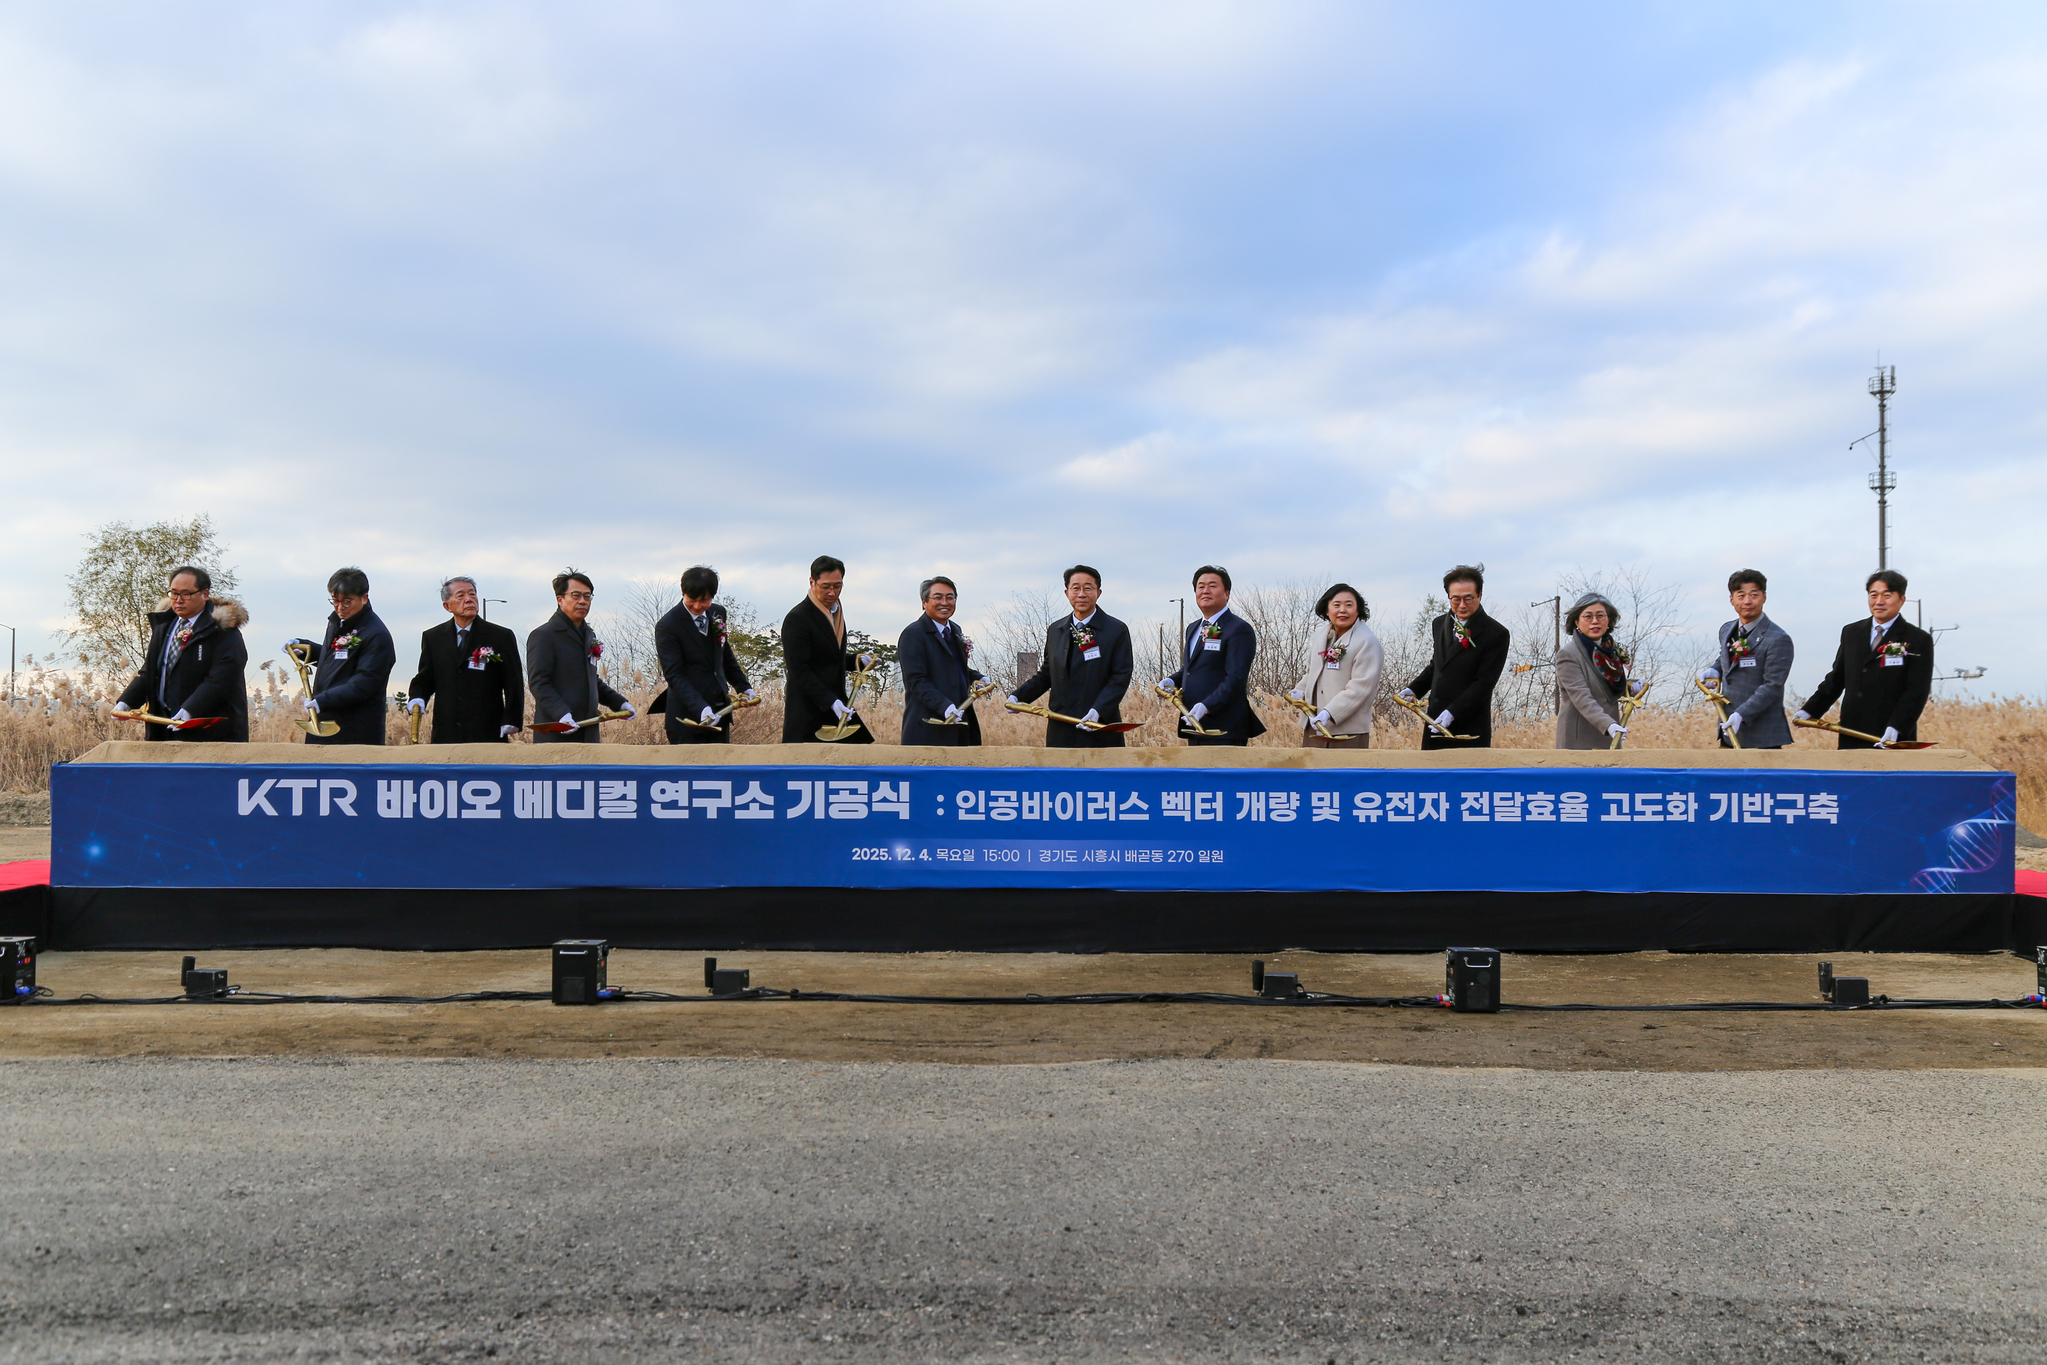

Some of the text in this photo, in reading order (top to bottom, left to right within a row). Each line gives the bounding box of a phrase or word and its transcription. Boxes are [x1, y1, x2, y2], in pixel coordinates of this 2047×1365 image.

[238, 779, 1839, 824] KTR 바이오 메디컬 연구소 기공식 : 인공바이러스 벡터 개량 및 유전자 전달효율 고도화 기반구축
[852, 848, 1223, 862] 2025. 12. 4. 목요일 15:00 경기도 시흥시 배곧동 270 일원
